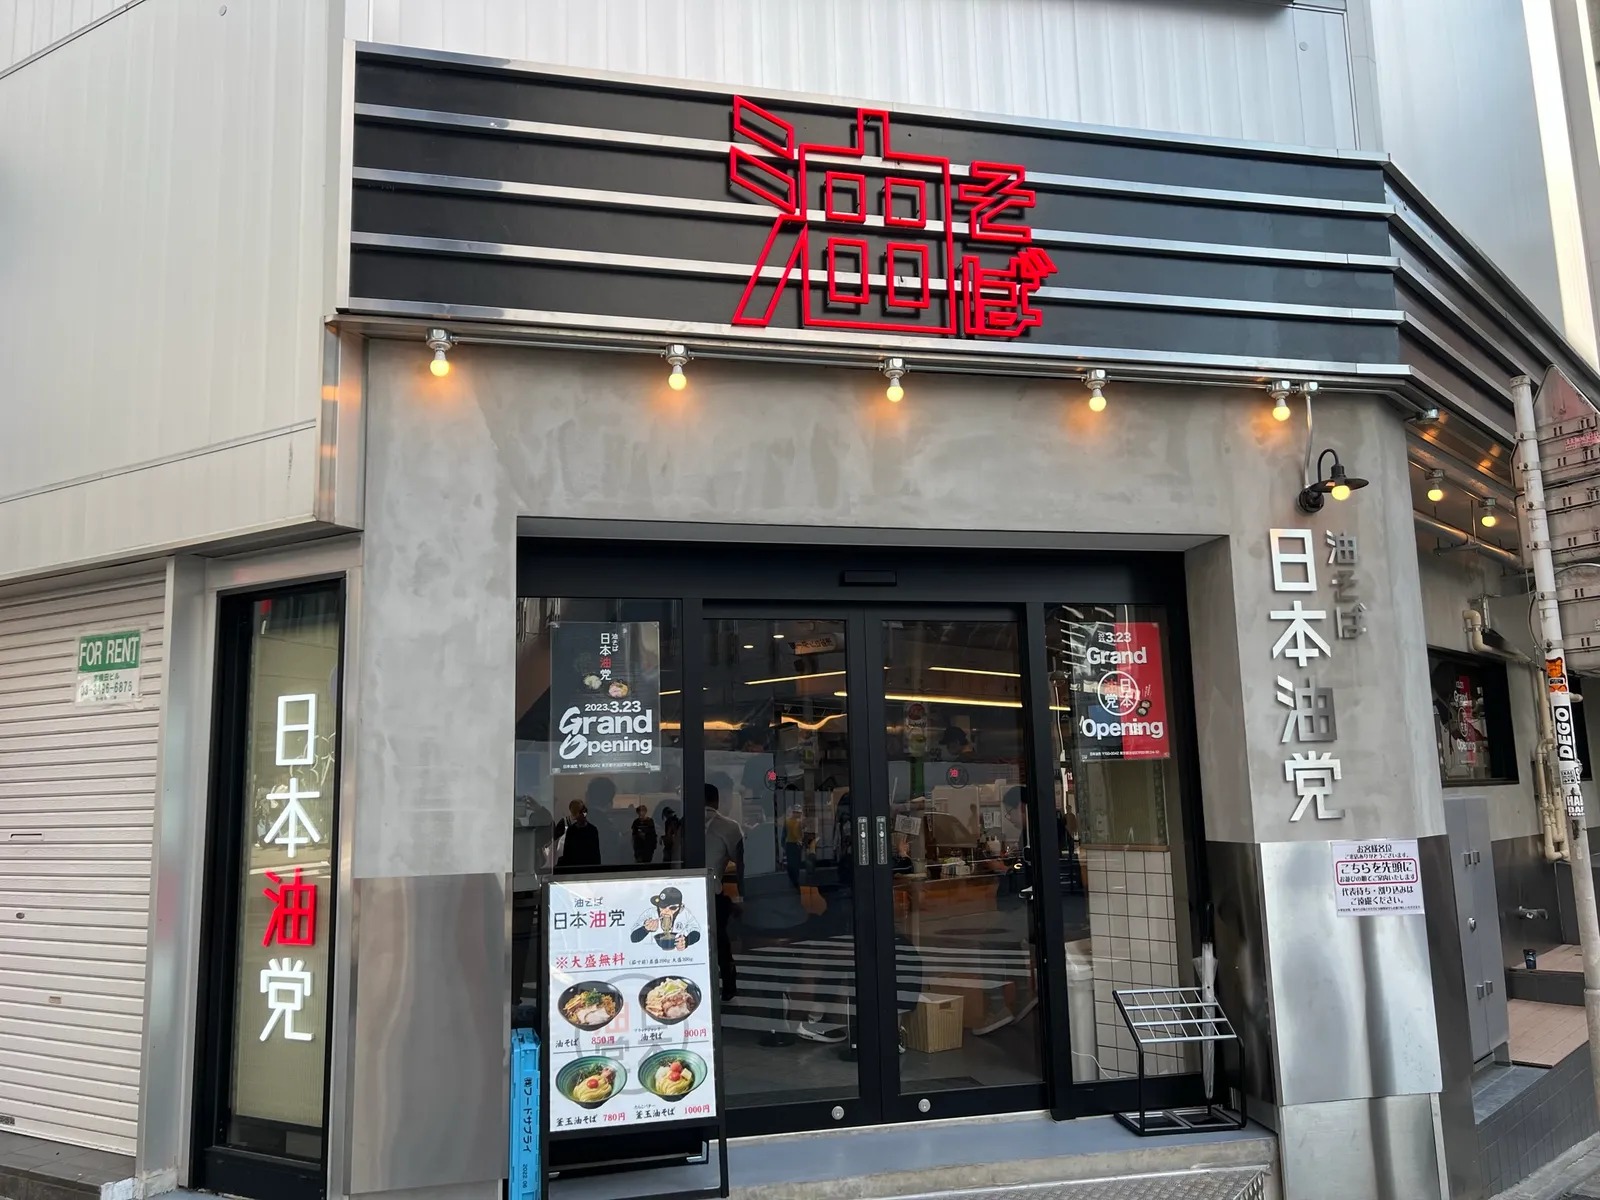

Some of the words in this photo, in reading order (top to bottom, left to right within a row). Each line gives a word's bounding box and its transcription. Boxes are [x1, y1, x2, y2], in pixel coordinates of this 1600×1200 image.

[1326, 529, 1367, 640] 油そば
[79, 641, 103, 667] FOR
[105, 636, 140, 664] RENT
[599, 633, 612, 681] 日本油党
[1086, 647, 1147, 665] Grand
[1269, 528, 1345, 822] 日本油党
[558, 706, 653, 735] Grand
[1082, 719, 1164, 740] Opening
[1555, 707, 1574, 760] DEGO
[559, 733, 653, 760] Opening
[259, 692, 321, 1042] 日本油党
[1341, 861, 1413, 875] こちらを先頭に
[574, 896, 603, 908] 油そば
[554, 909, 626, 931] 日本油党
[555, 1037, 580, 1048] 油そば
[591, 1035, 615, 1045] 850円
[640, 1032, 664, 1042] 油そば
[684, 1028, 707, 1038] 900円
[556, 1114, 598, 1127] 釜玉油そば
[603, 1112, 626, 1122] 780円
[635, 1106, 676, 1120] 釜玉油そば
[684, 1104, 710, 1116] 1000円
